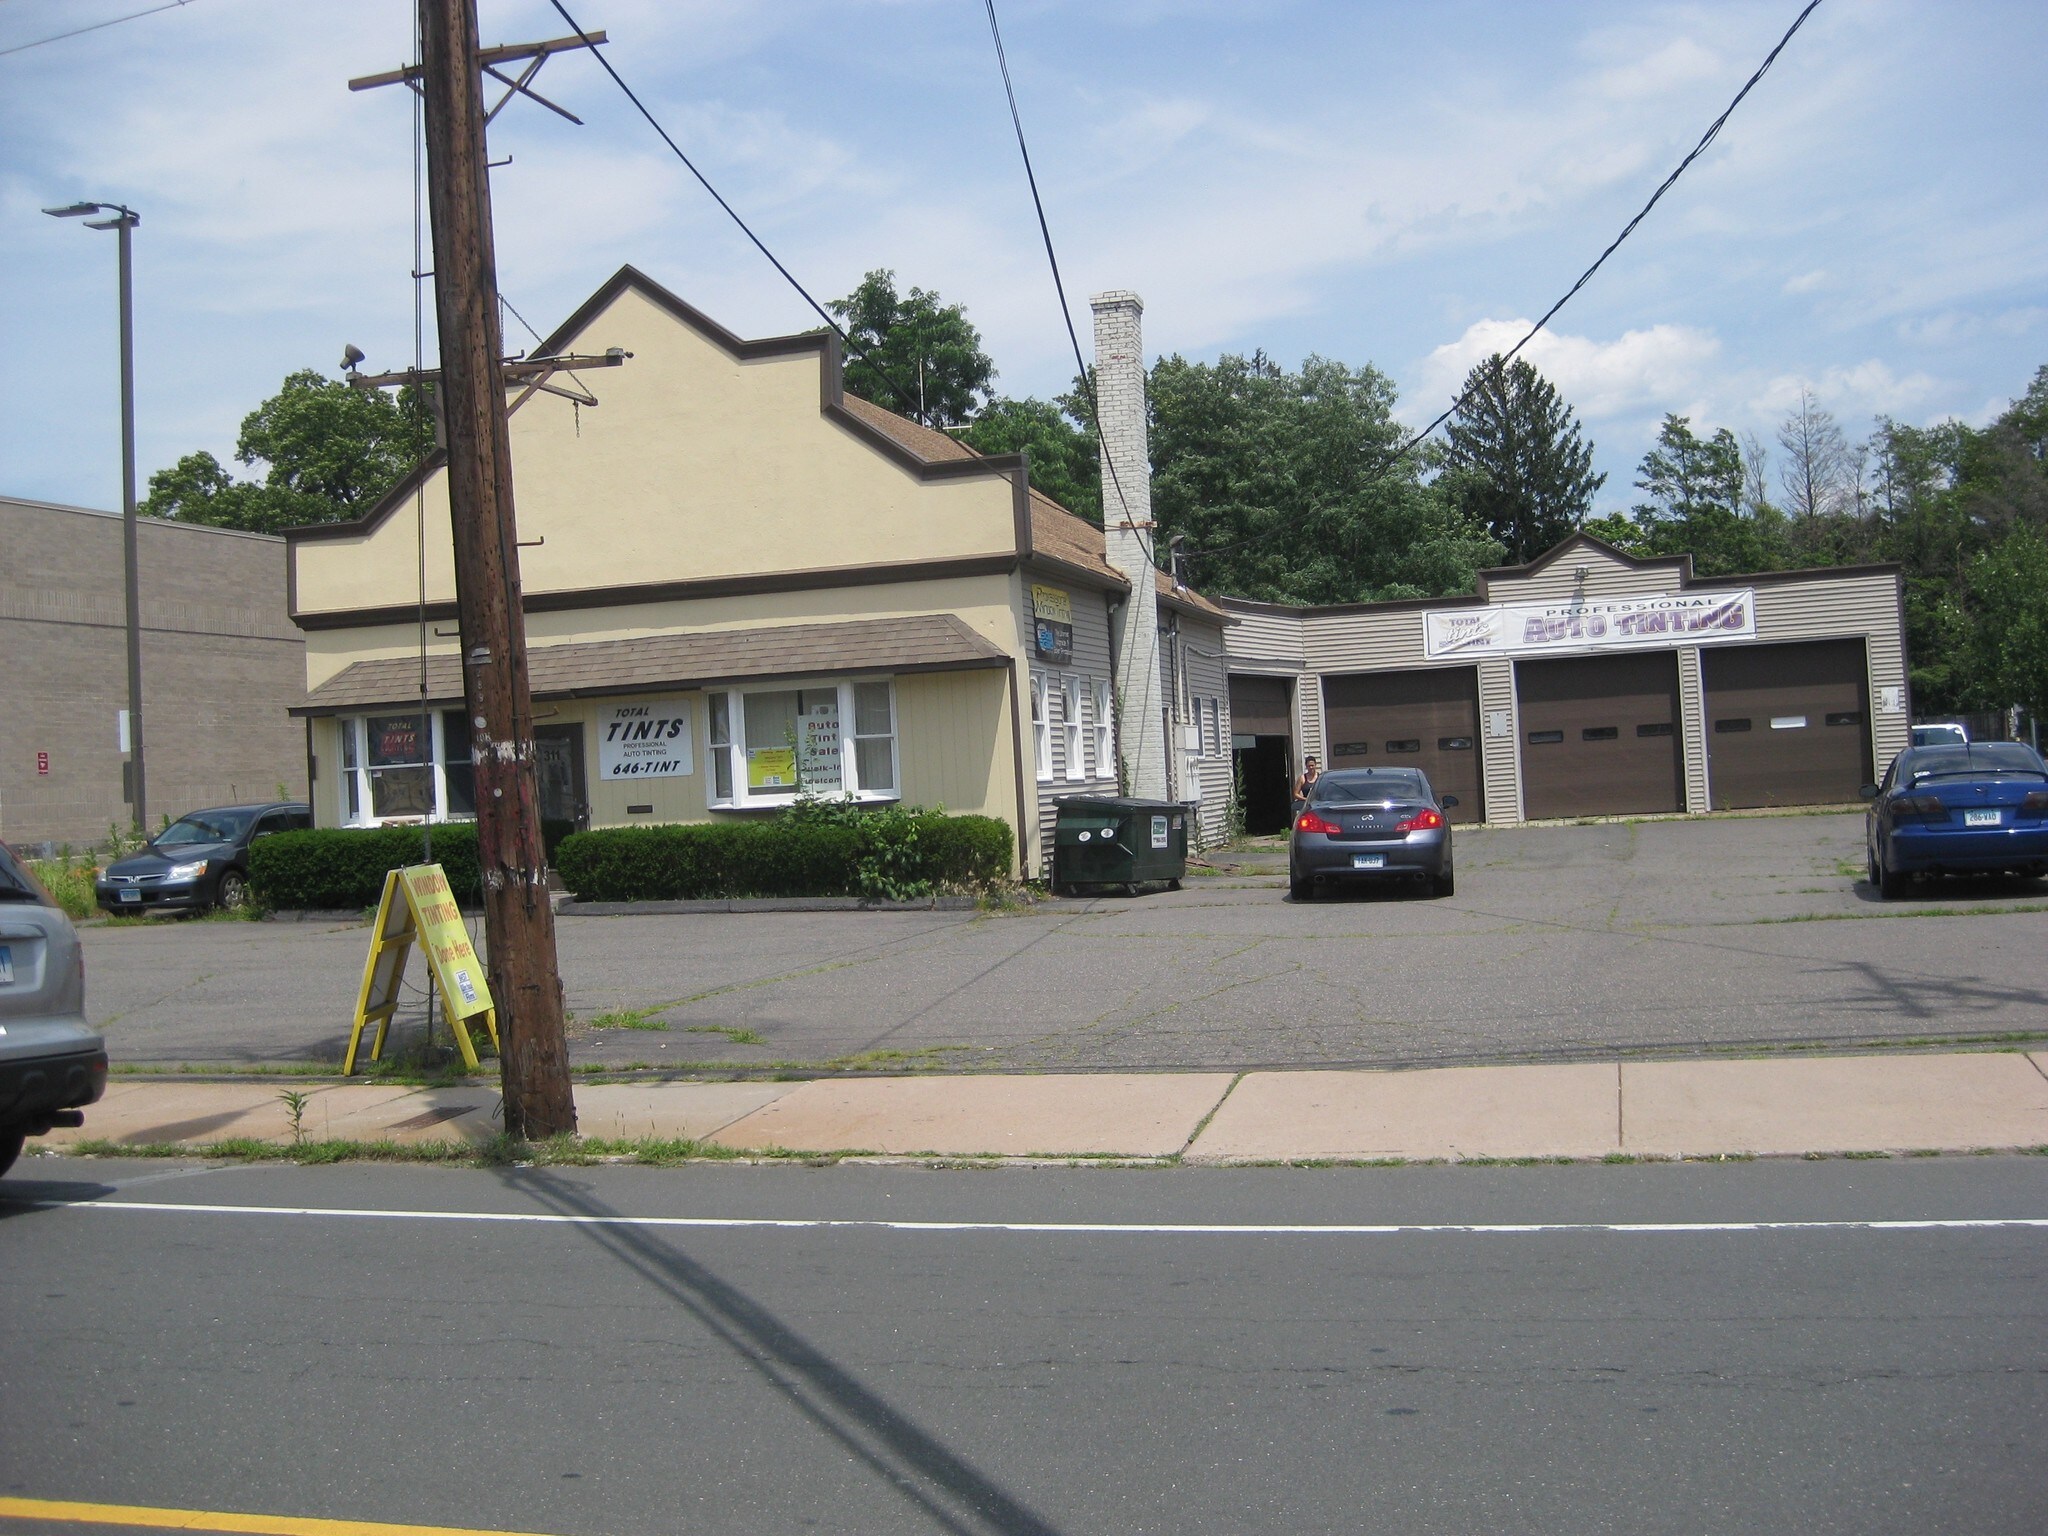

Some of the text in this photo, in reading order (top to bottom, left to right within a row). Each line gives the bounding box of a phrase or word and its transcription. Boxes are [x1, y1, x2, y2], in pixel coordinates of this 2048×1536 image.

[1546, 599, 1718, 617] PROFESSIONAL
[1523, 602, 1745, 643] AUTO TINTING
[616, 706, 649, 718] TOTAL
[388, 722, 412, 730] TOTAL
[606, 718, 684, 742] TINTS
[808, 721, 840, 730] Auto
[384, 732, 416, 744] TINTS
[810, 733, 837, 742] Tint
[623, 741, 667, 749] PROFESSIONAL
[810, 747, 839, 756] Sale
[612, 760, 681, 775] 646-TINT
[410, 873, 448, 897] WINDOW
[421, 901, 458, 927] TINTING
[434, 939, 472, 964] Done Here
